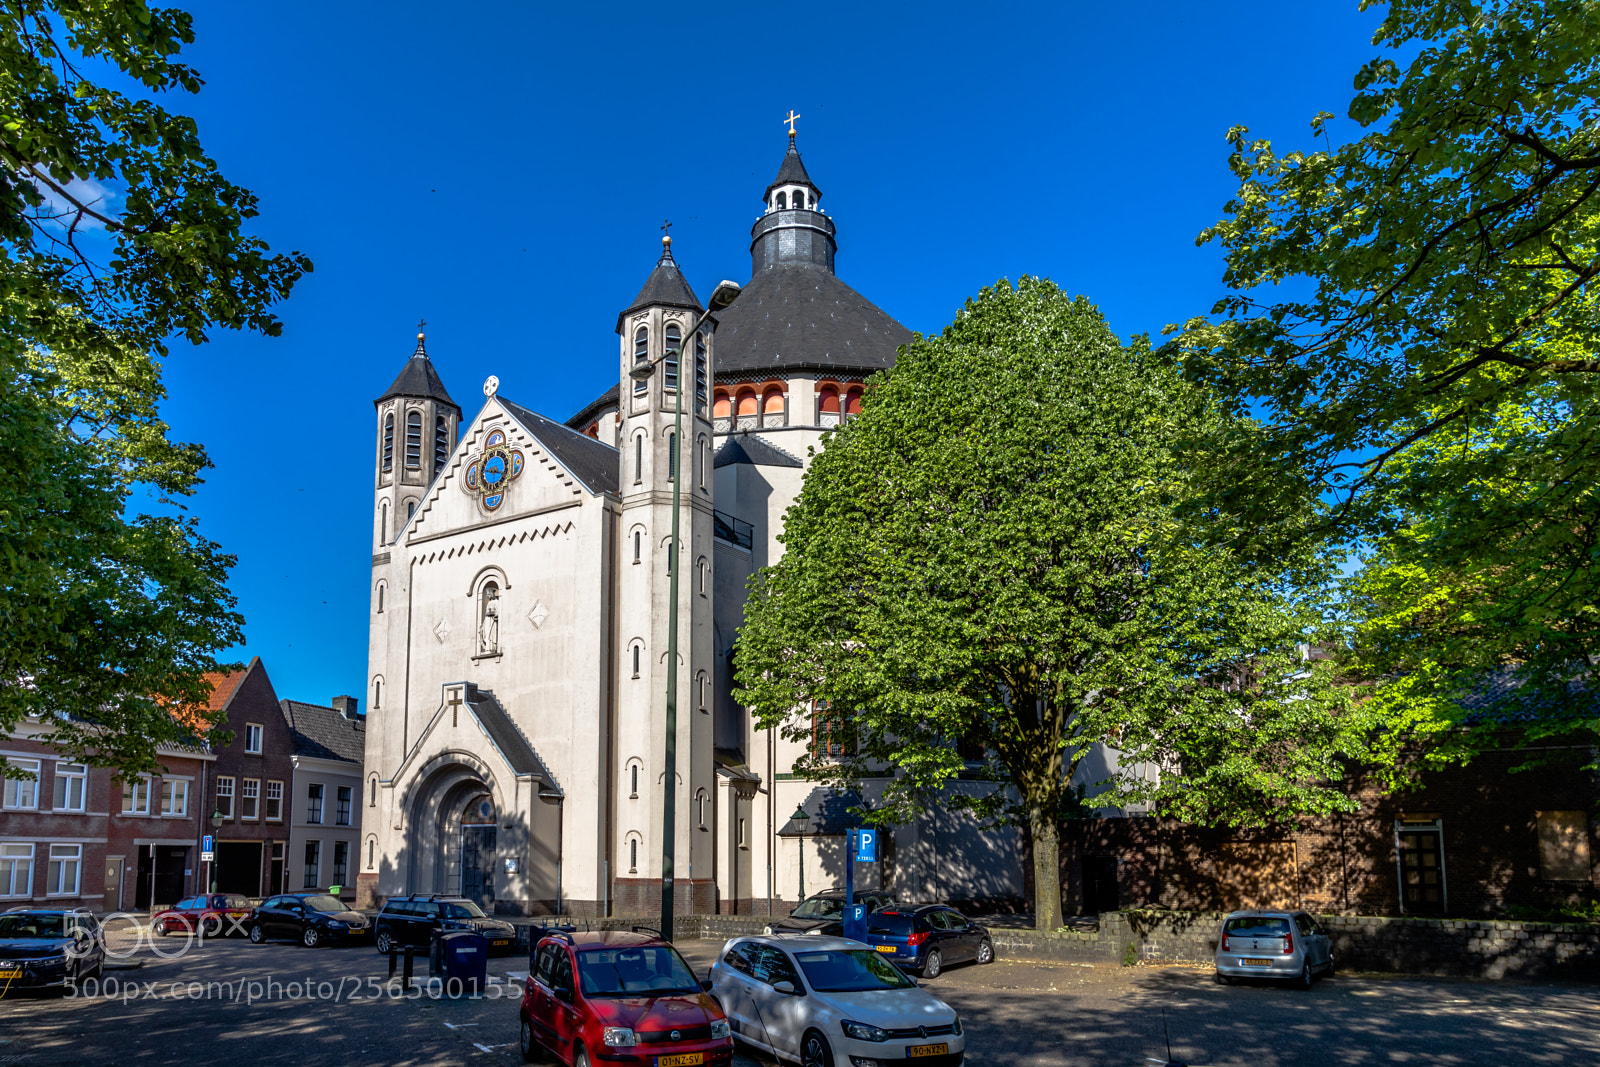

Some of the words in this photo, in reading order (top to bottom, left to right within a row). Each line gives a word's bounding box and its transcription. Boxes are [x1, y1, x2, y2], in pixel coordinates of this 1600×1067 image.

[862, 833, 872, 850] P
[855, 908, 862, 919] P
[913, 1045, 945, 1056] 90-NXZ-1
[662, 1054, 700, 1067] 01-NZ-SV
